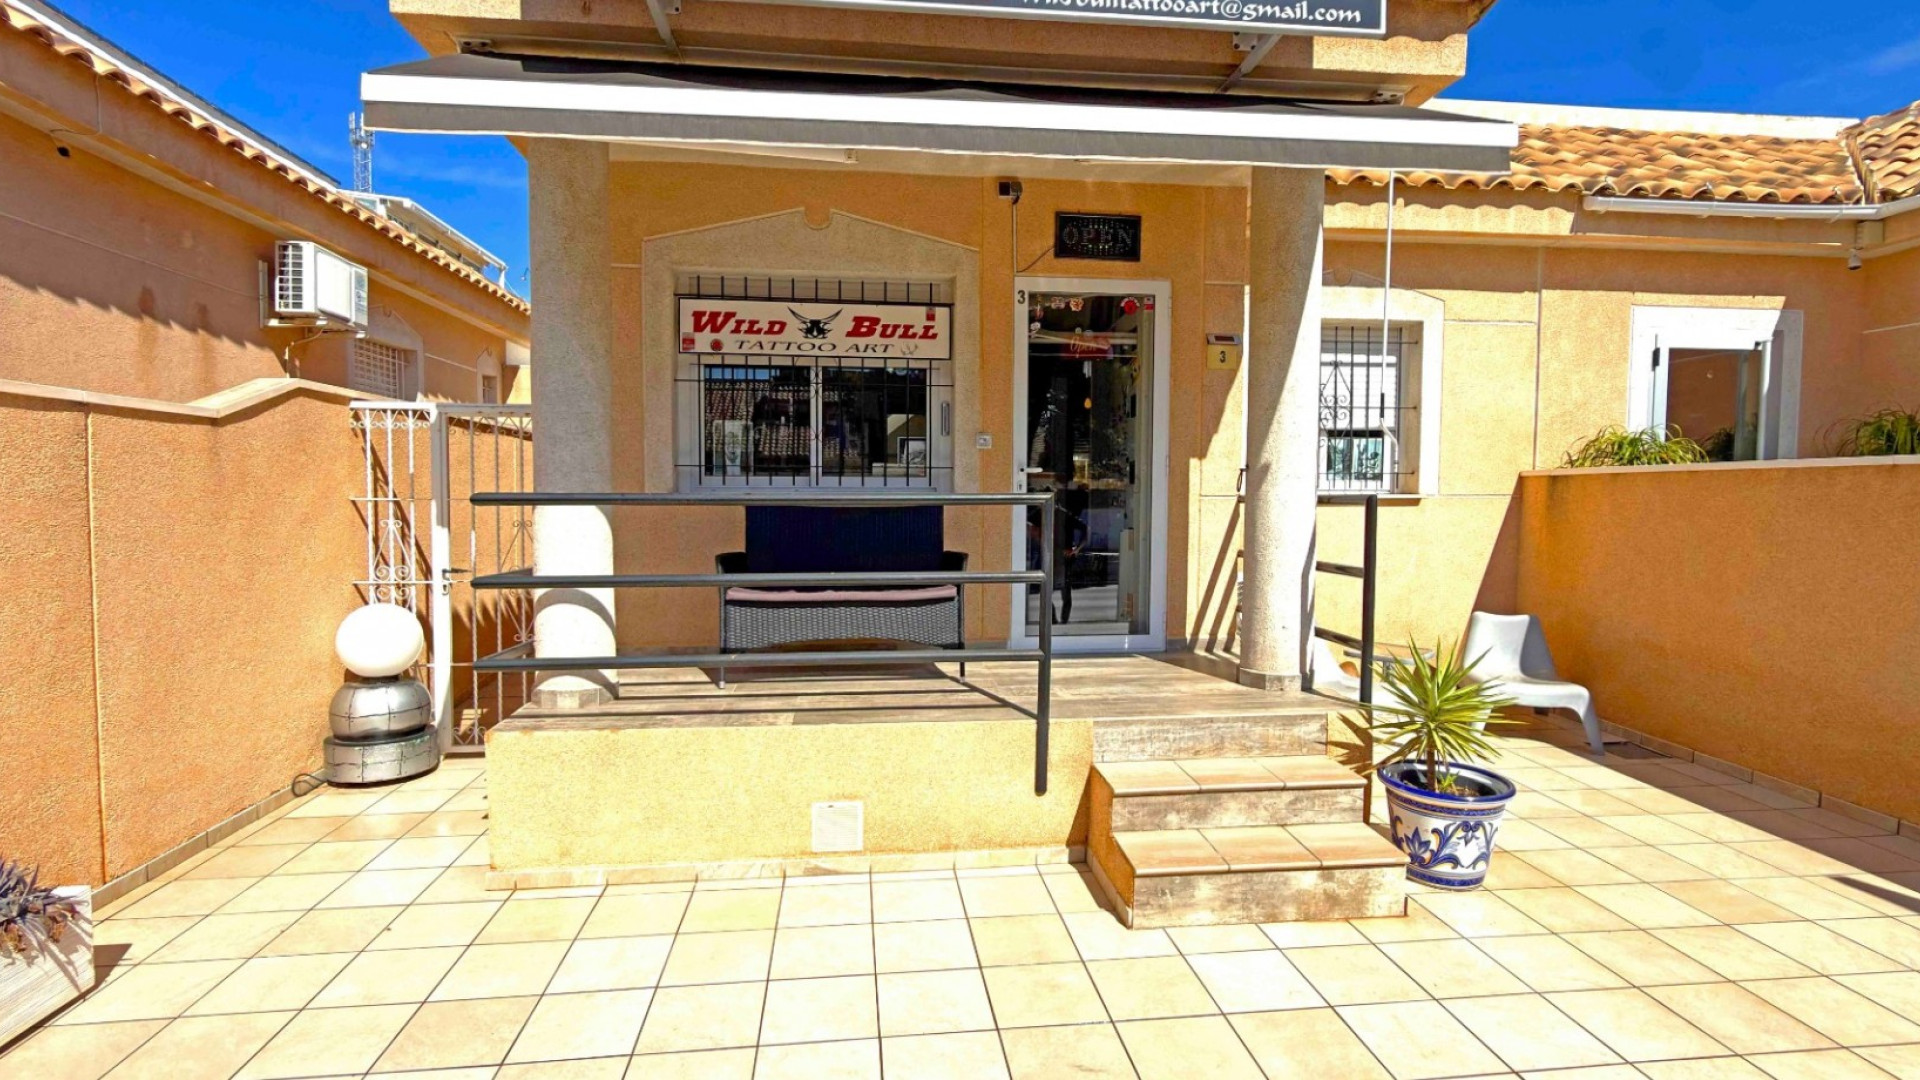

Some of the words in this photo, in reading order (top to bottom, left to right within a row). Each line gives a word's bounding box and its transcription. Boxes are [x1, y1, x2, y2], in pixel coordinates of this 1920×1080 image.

[1023, 0, 1362, 23] utattooart@gmail.com
[1063, 223, 1135, 250] OPEN
[1017, 289, 1026, 304] 3
[691, 310, 788, 336] WILD
[845, 315, 939, 340] BULL
[735, 340, 837, 352] TATTOO
[845, 343, 895, 353] ART
[1219, 350, 1226, 363] 3
